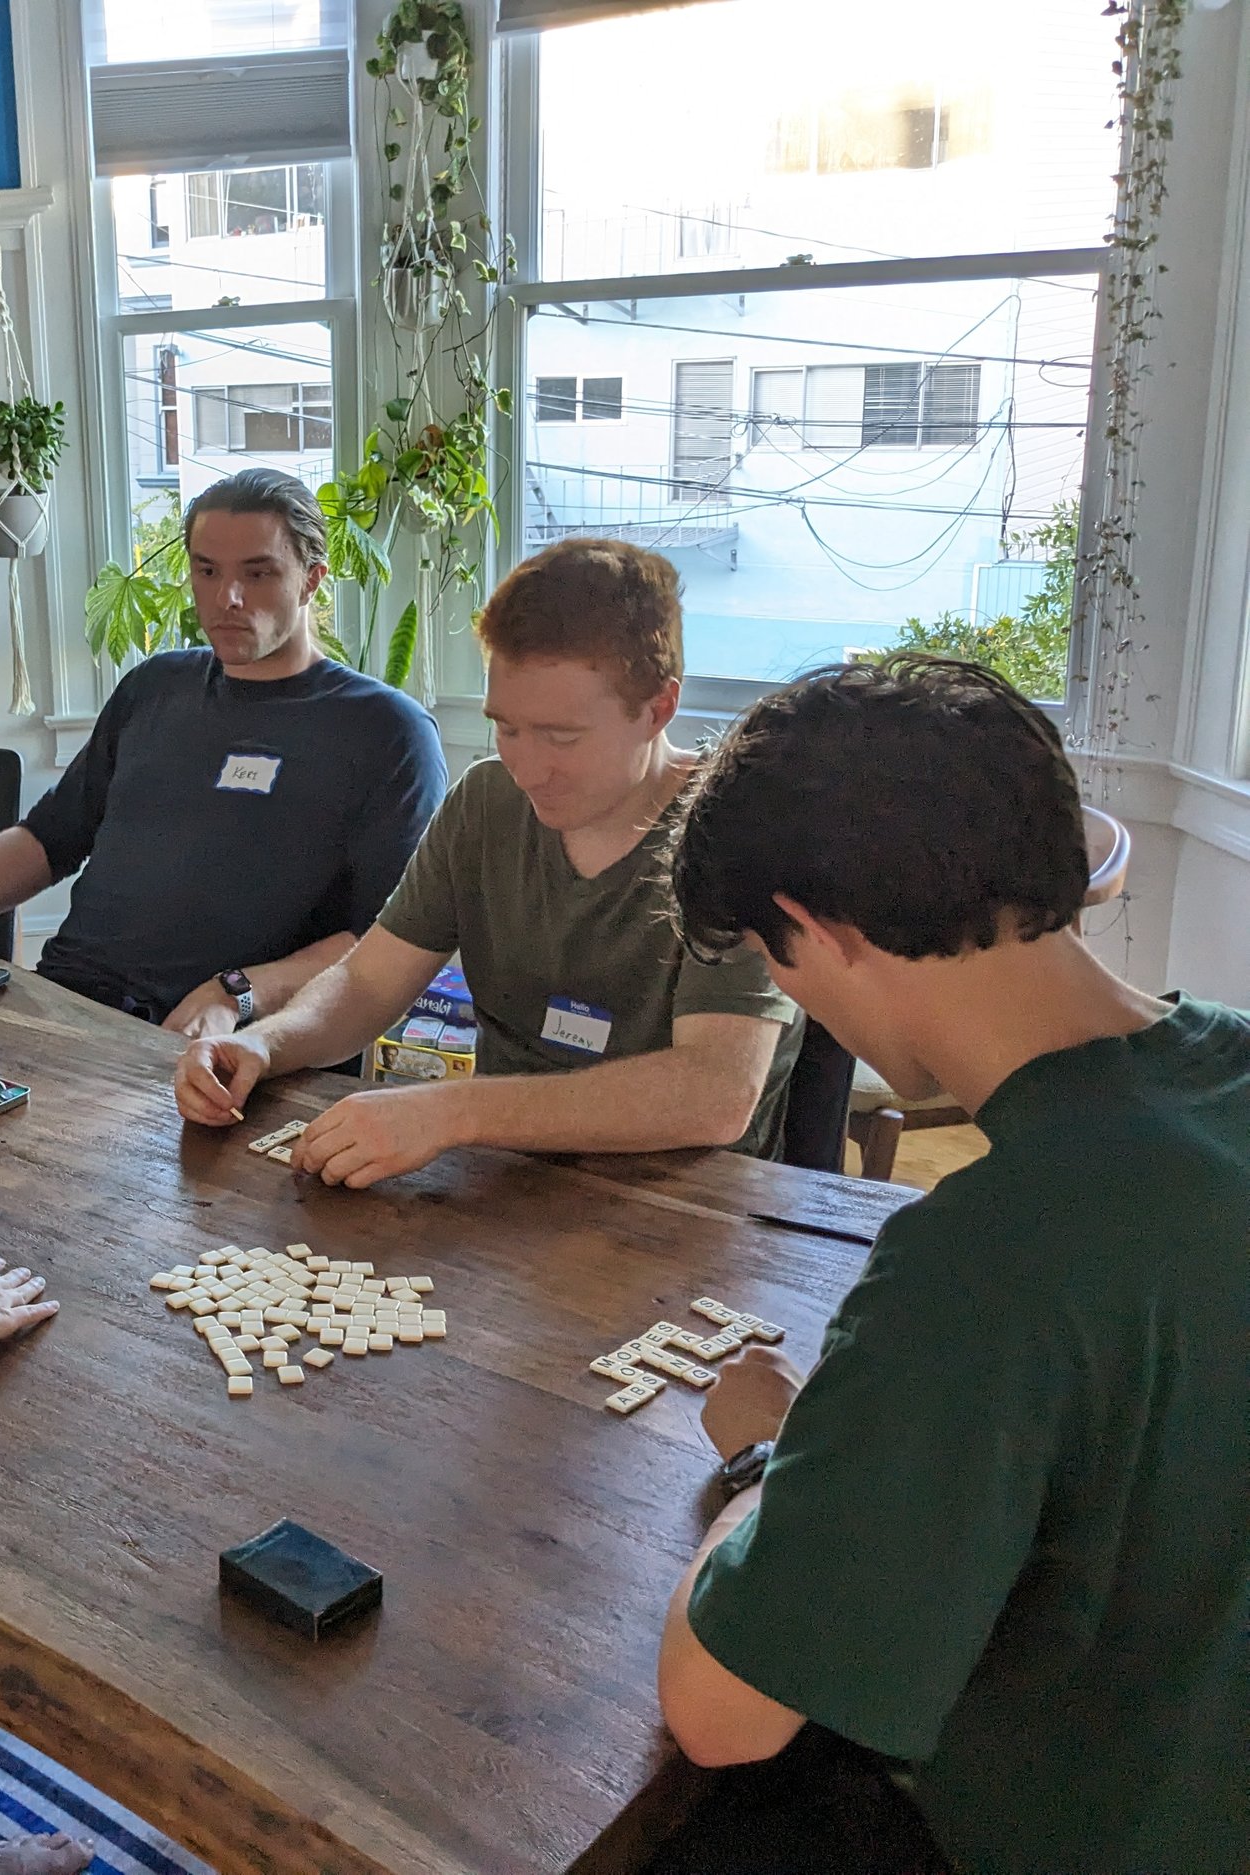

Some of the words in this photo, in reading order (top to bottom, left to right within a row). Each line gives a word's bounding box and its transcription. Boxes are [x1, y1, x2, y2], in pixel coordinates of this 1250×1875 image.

[414, 997, 452, 1016] anabi
[570, 1000, 590, 1013] Hello
[552, 1015, 594, 1048] Jeremy
